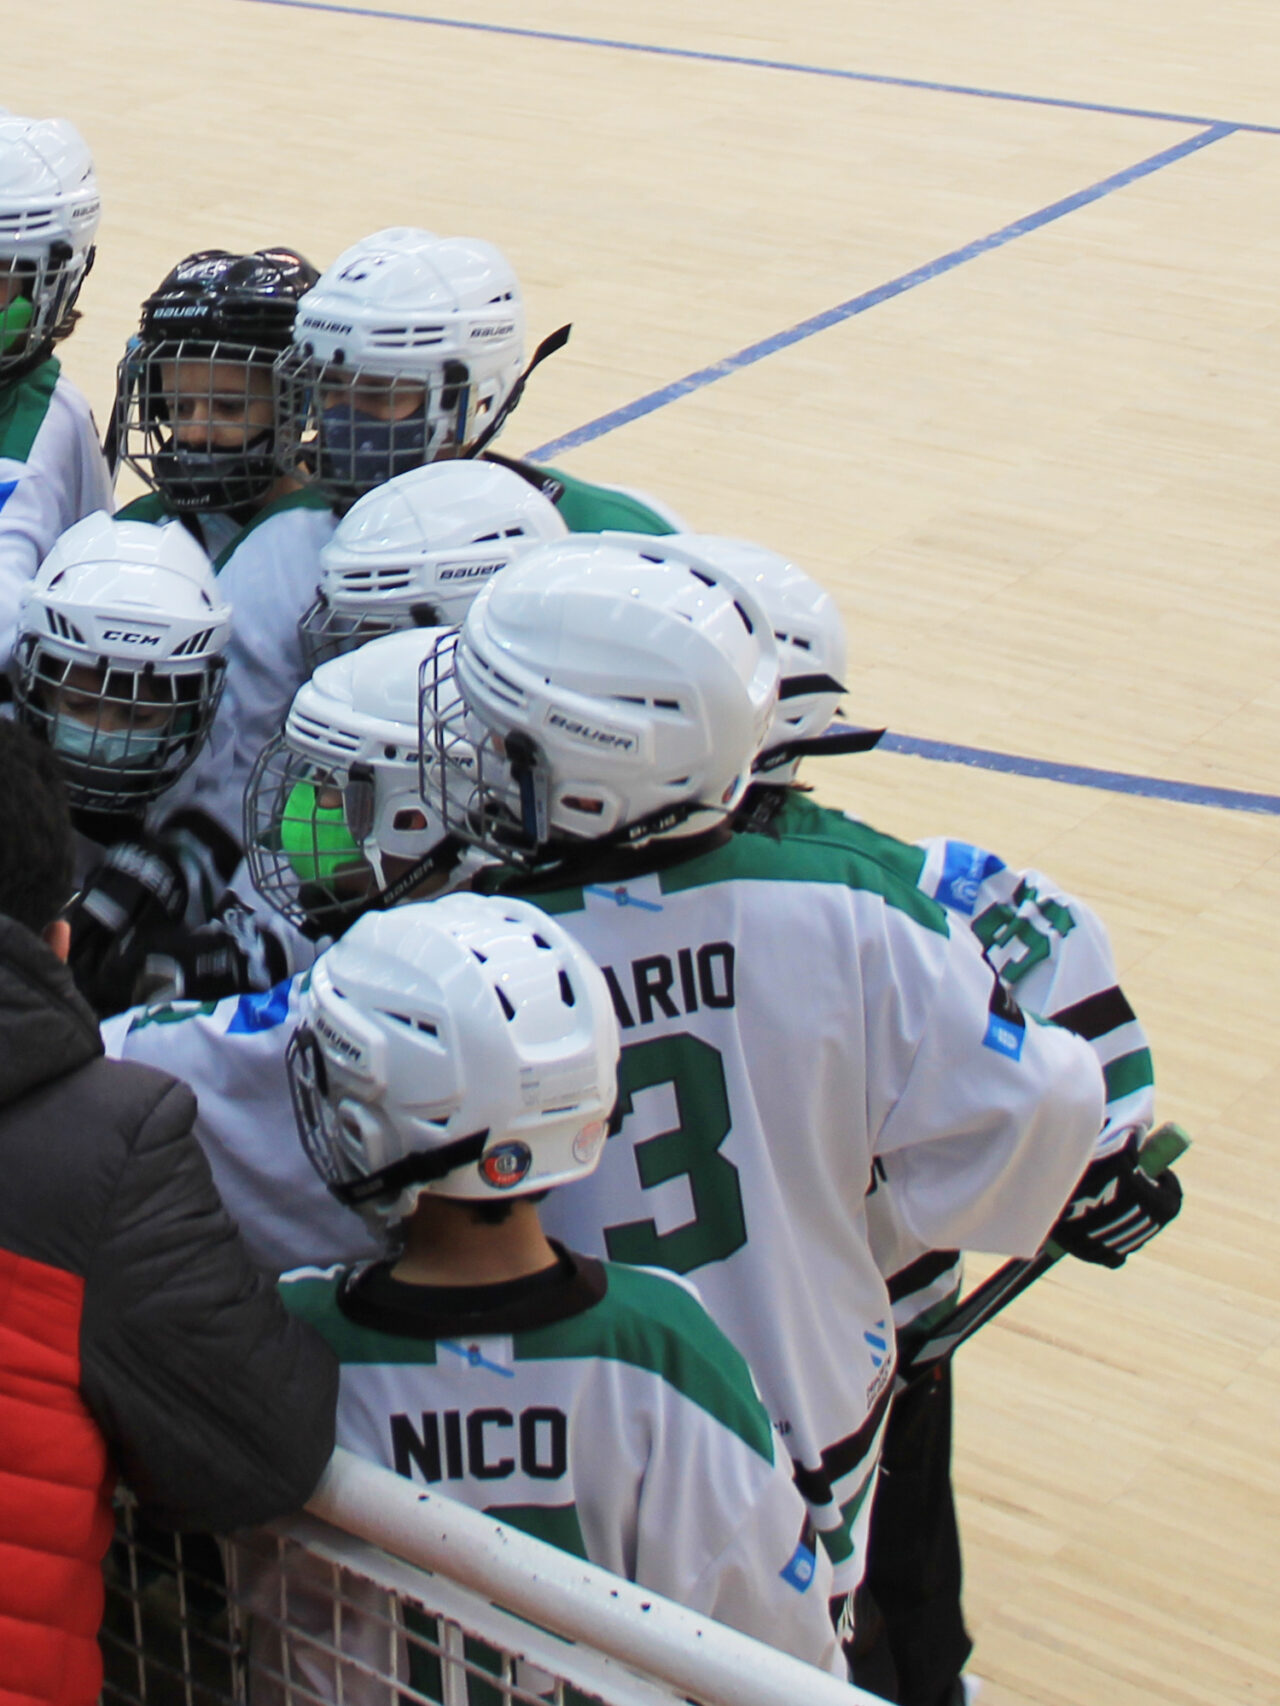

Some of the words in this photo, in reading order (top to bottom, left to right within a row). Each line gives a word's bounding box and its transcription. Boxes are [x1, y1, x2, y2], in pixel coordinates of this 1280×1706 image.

[153, 305, 209, 319] BAUER
[303, 318, 353, 336] BAUER
[470, 325, 515, 338] BAUER
[102, 630, 162, 646] CCM
[549, 713, 634, 750] BAUER
[316, 1018, 362, 1061] BAUER
[602, 1031, 748, 1276] 3
[389, 1406, 568, 1485] NICO
